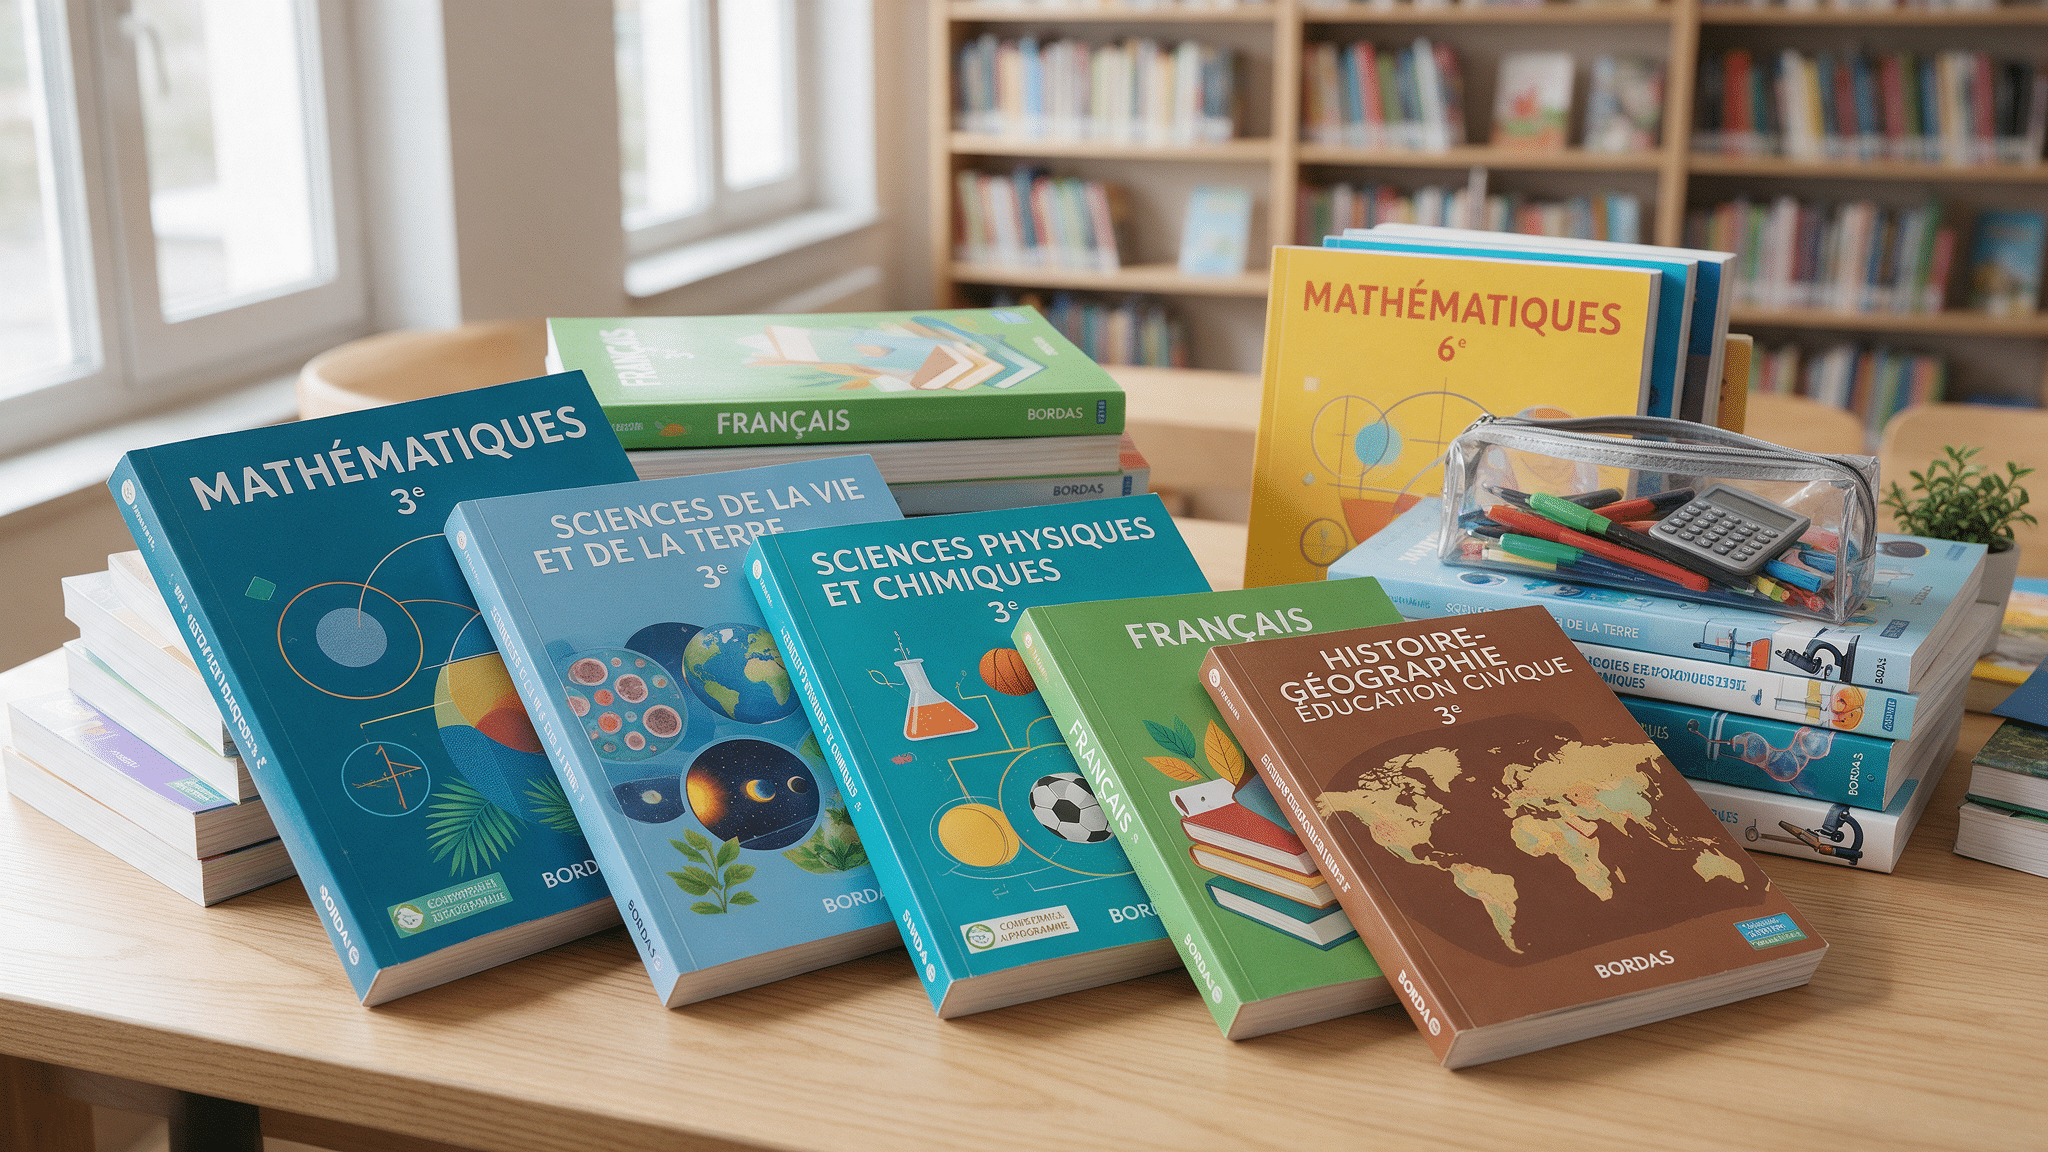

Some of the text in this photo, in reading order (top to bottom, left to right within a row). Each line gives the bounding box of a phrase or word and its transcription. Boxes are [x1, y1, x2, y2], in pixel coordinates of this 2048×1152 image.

[1302, 278, 1623, 337] MATHÉMATIQUES
[717, 409, 850, 439] FRANÇAIS
[1027, 407, 1084, 420] BORDAS
[189, 405, 588, 511] MATHÉMATIQUES
[550, 477, 865, 539] SCIENCES DE LA VIE
[1053, 483, 1104, 496] BORDAS
[533, 546, 574, 575] ET
[583, 538, 635, 568] DE
[637, 532, 686, 560] LA
[811, 516, 1156, 576] SCIENCES PHYSIQUES
[821, 558, 1062, 608] ET CHIMIQUES
[1124, 607, 1313, 649] FRANÇAIS
[1319, 627, 1486, 671] HISTOIRE-
[1566, 618, 1583, 631] DE
[1585, 619, 1600, 634] LA
[1602, 623, 1640, 639] TERRE
[1280, 646, 1508, 703] GÉOGRAPHIE
[1294, 656, 1573, 723] ÉDUCATION CIVIQUE
[1069, 719, 1132, 833] FRANÇAIS
[1848, 752, 1864, 796] BORDAS
[1108, 902, 1158, 924] BOR
[1593, 949, 1675, 979] BORDAS
